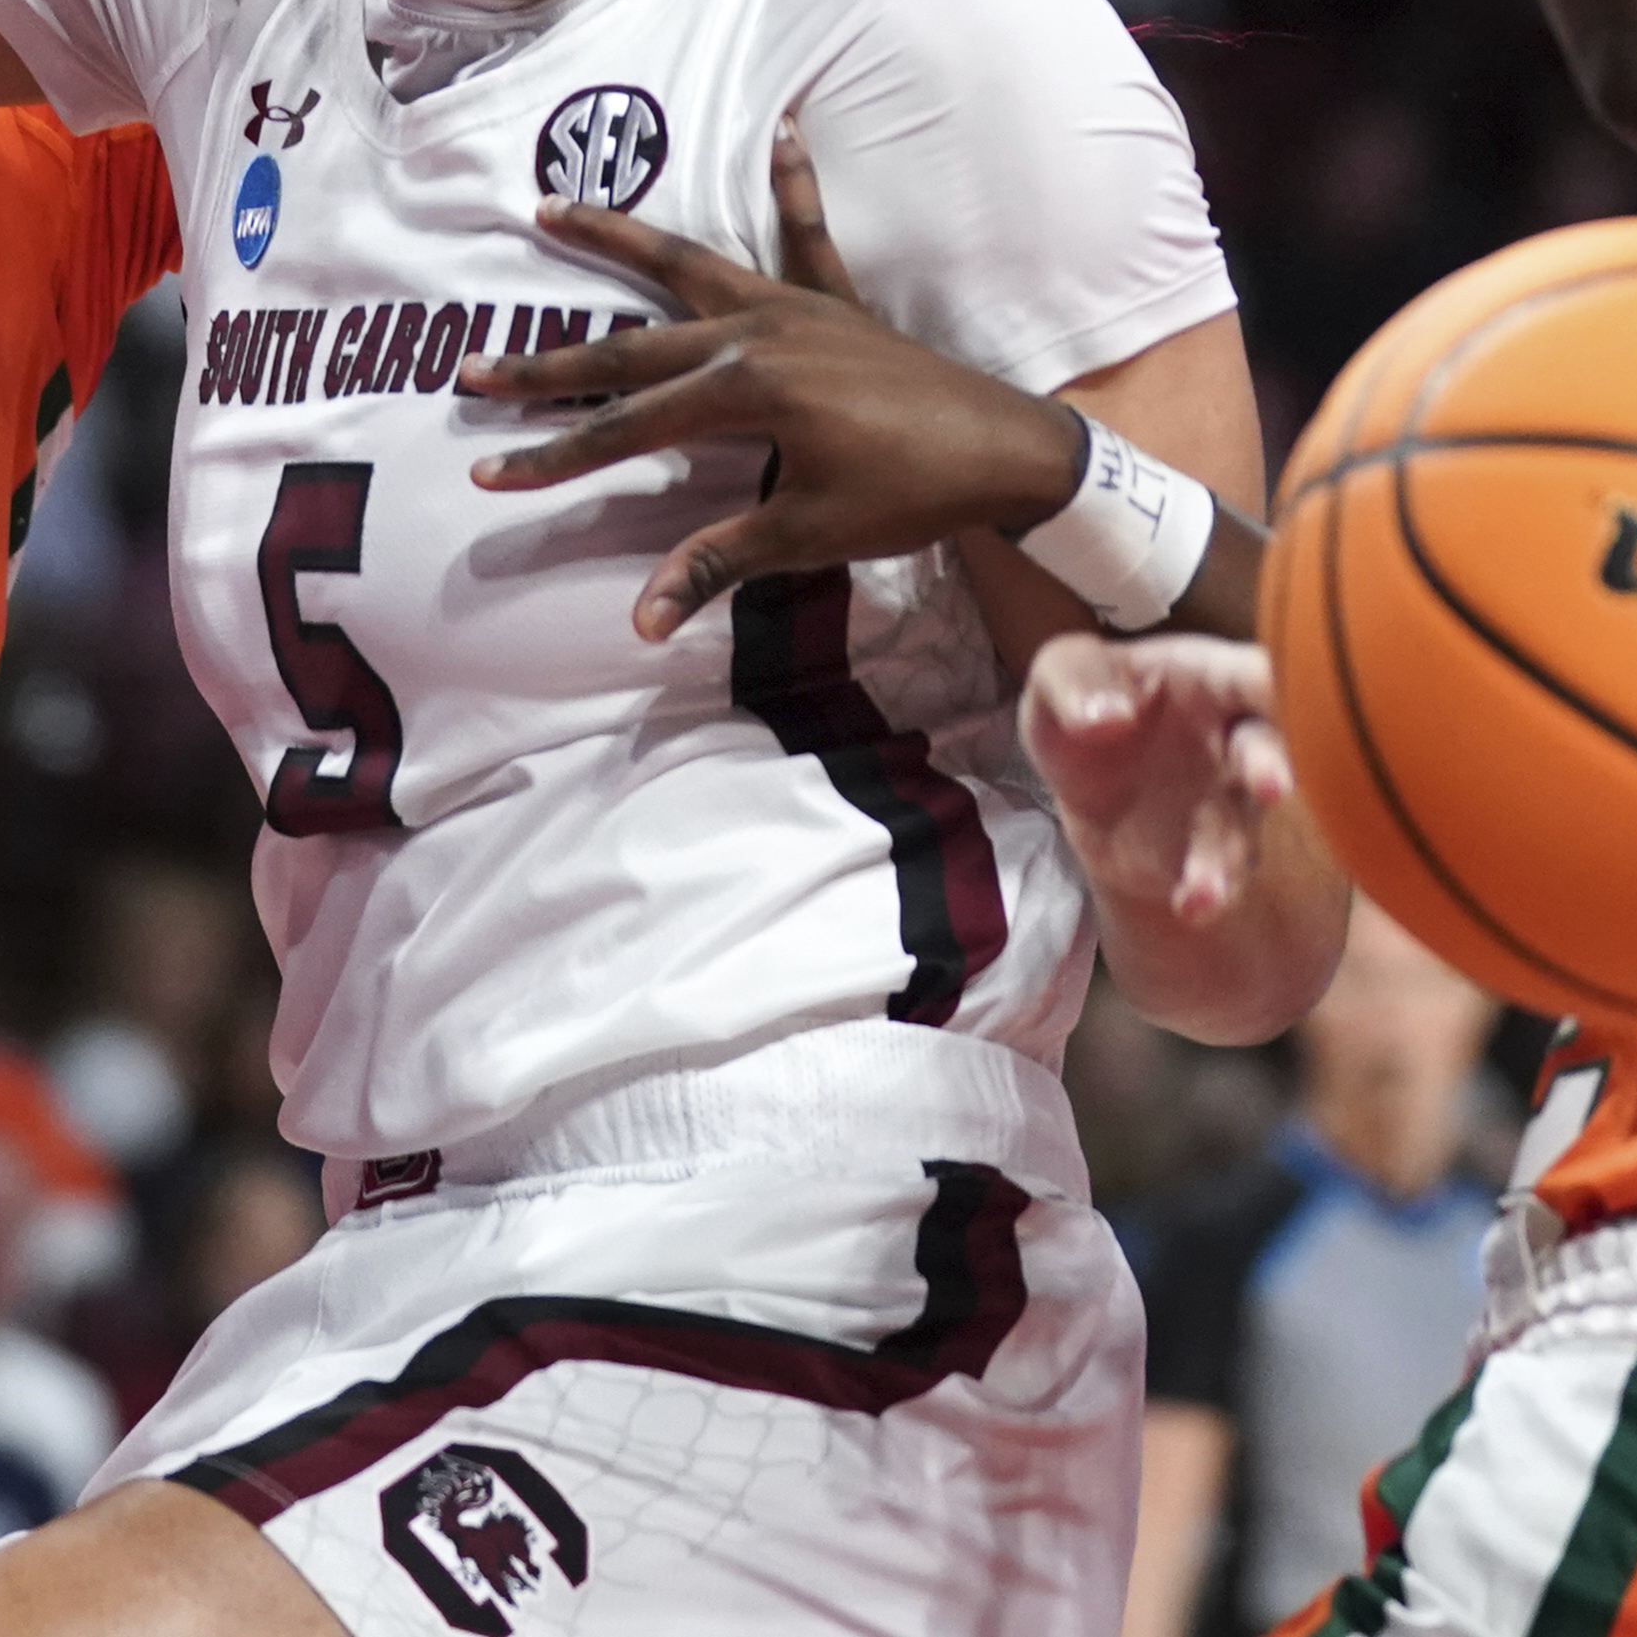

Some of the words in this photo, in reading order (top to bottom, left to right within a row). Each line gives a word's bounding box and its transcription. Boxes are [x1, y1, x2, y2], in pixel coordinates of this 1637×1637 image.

[546, 91, 658, 209] SEC
[198, 308, 328, 406] SOUTH
[257, 462, 403, 840] 5
